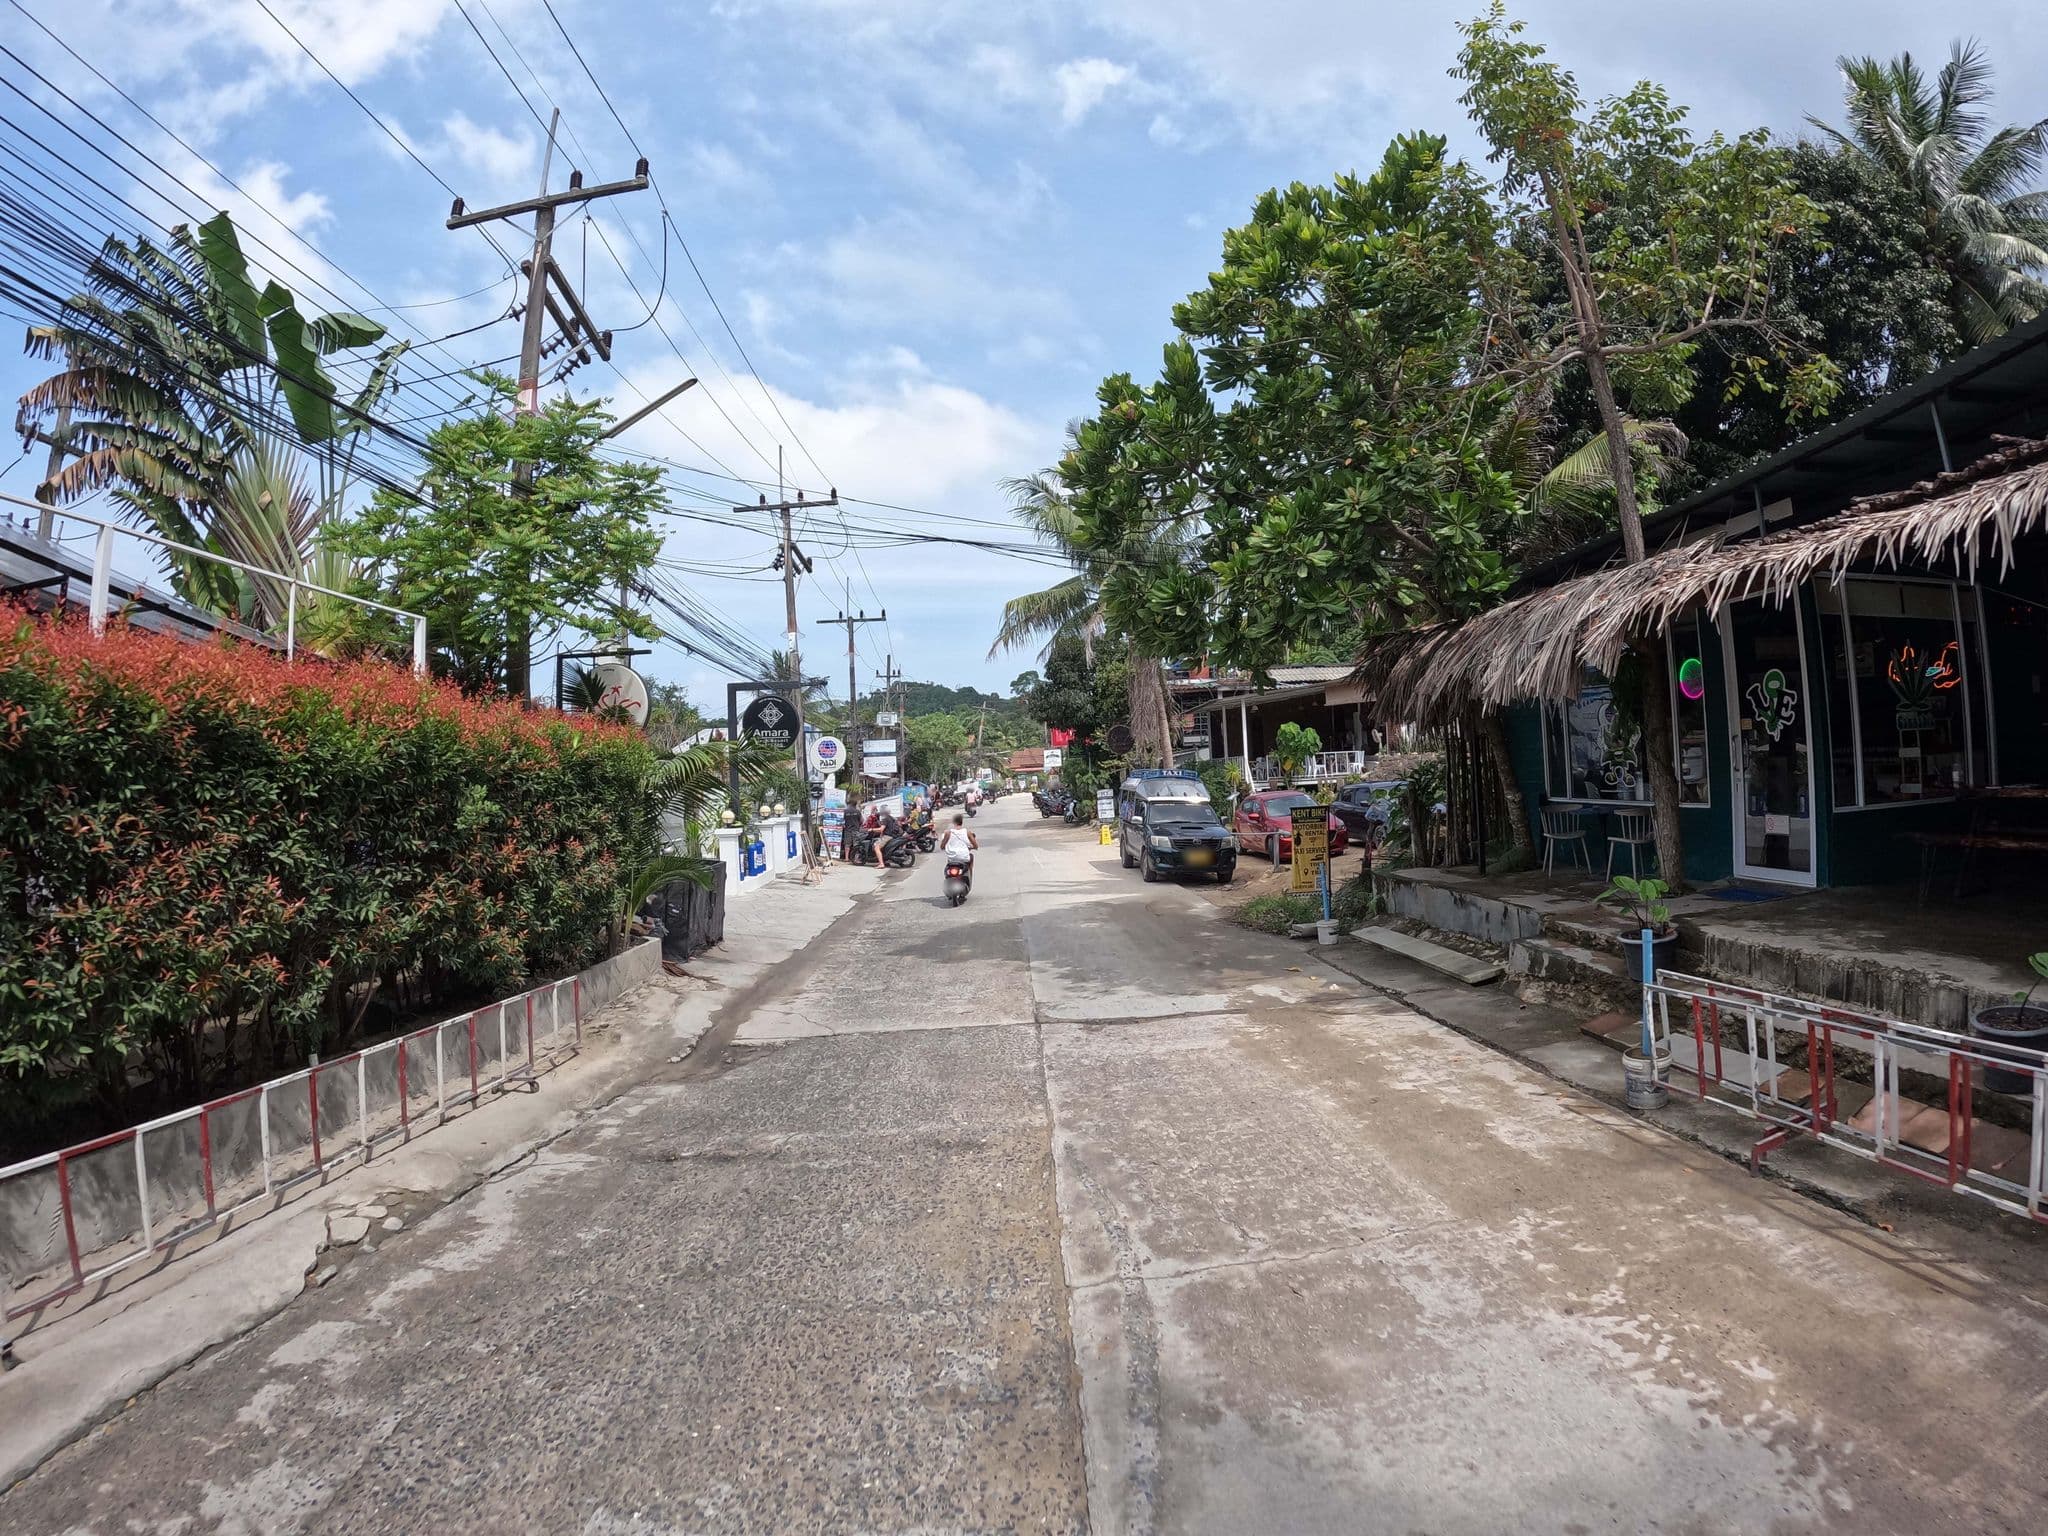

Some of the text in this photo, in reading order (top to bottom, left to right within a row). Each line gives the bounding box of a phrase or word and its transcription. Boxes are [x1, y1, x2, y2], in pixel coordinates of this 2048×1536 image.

[752, 728, 789, 737] Amara
[1311, 807, 1326, 817] BIKE
[1306, 846, 1327, 854] SERVICE
